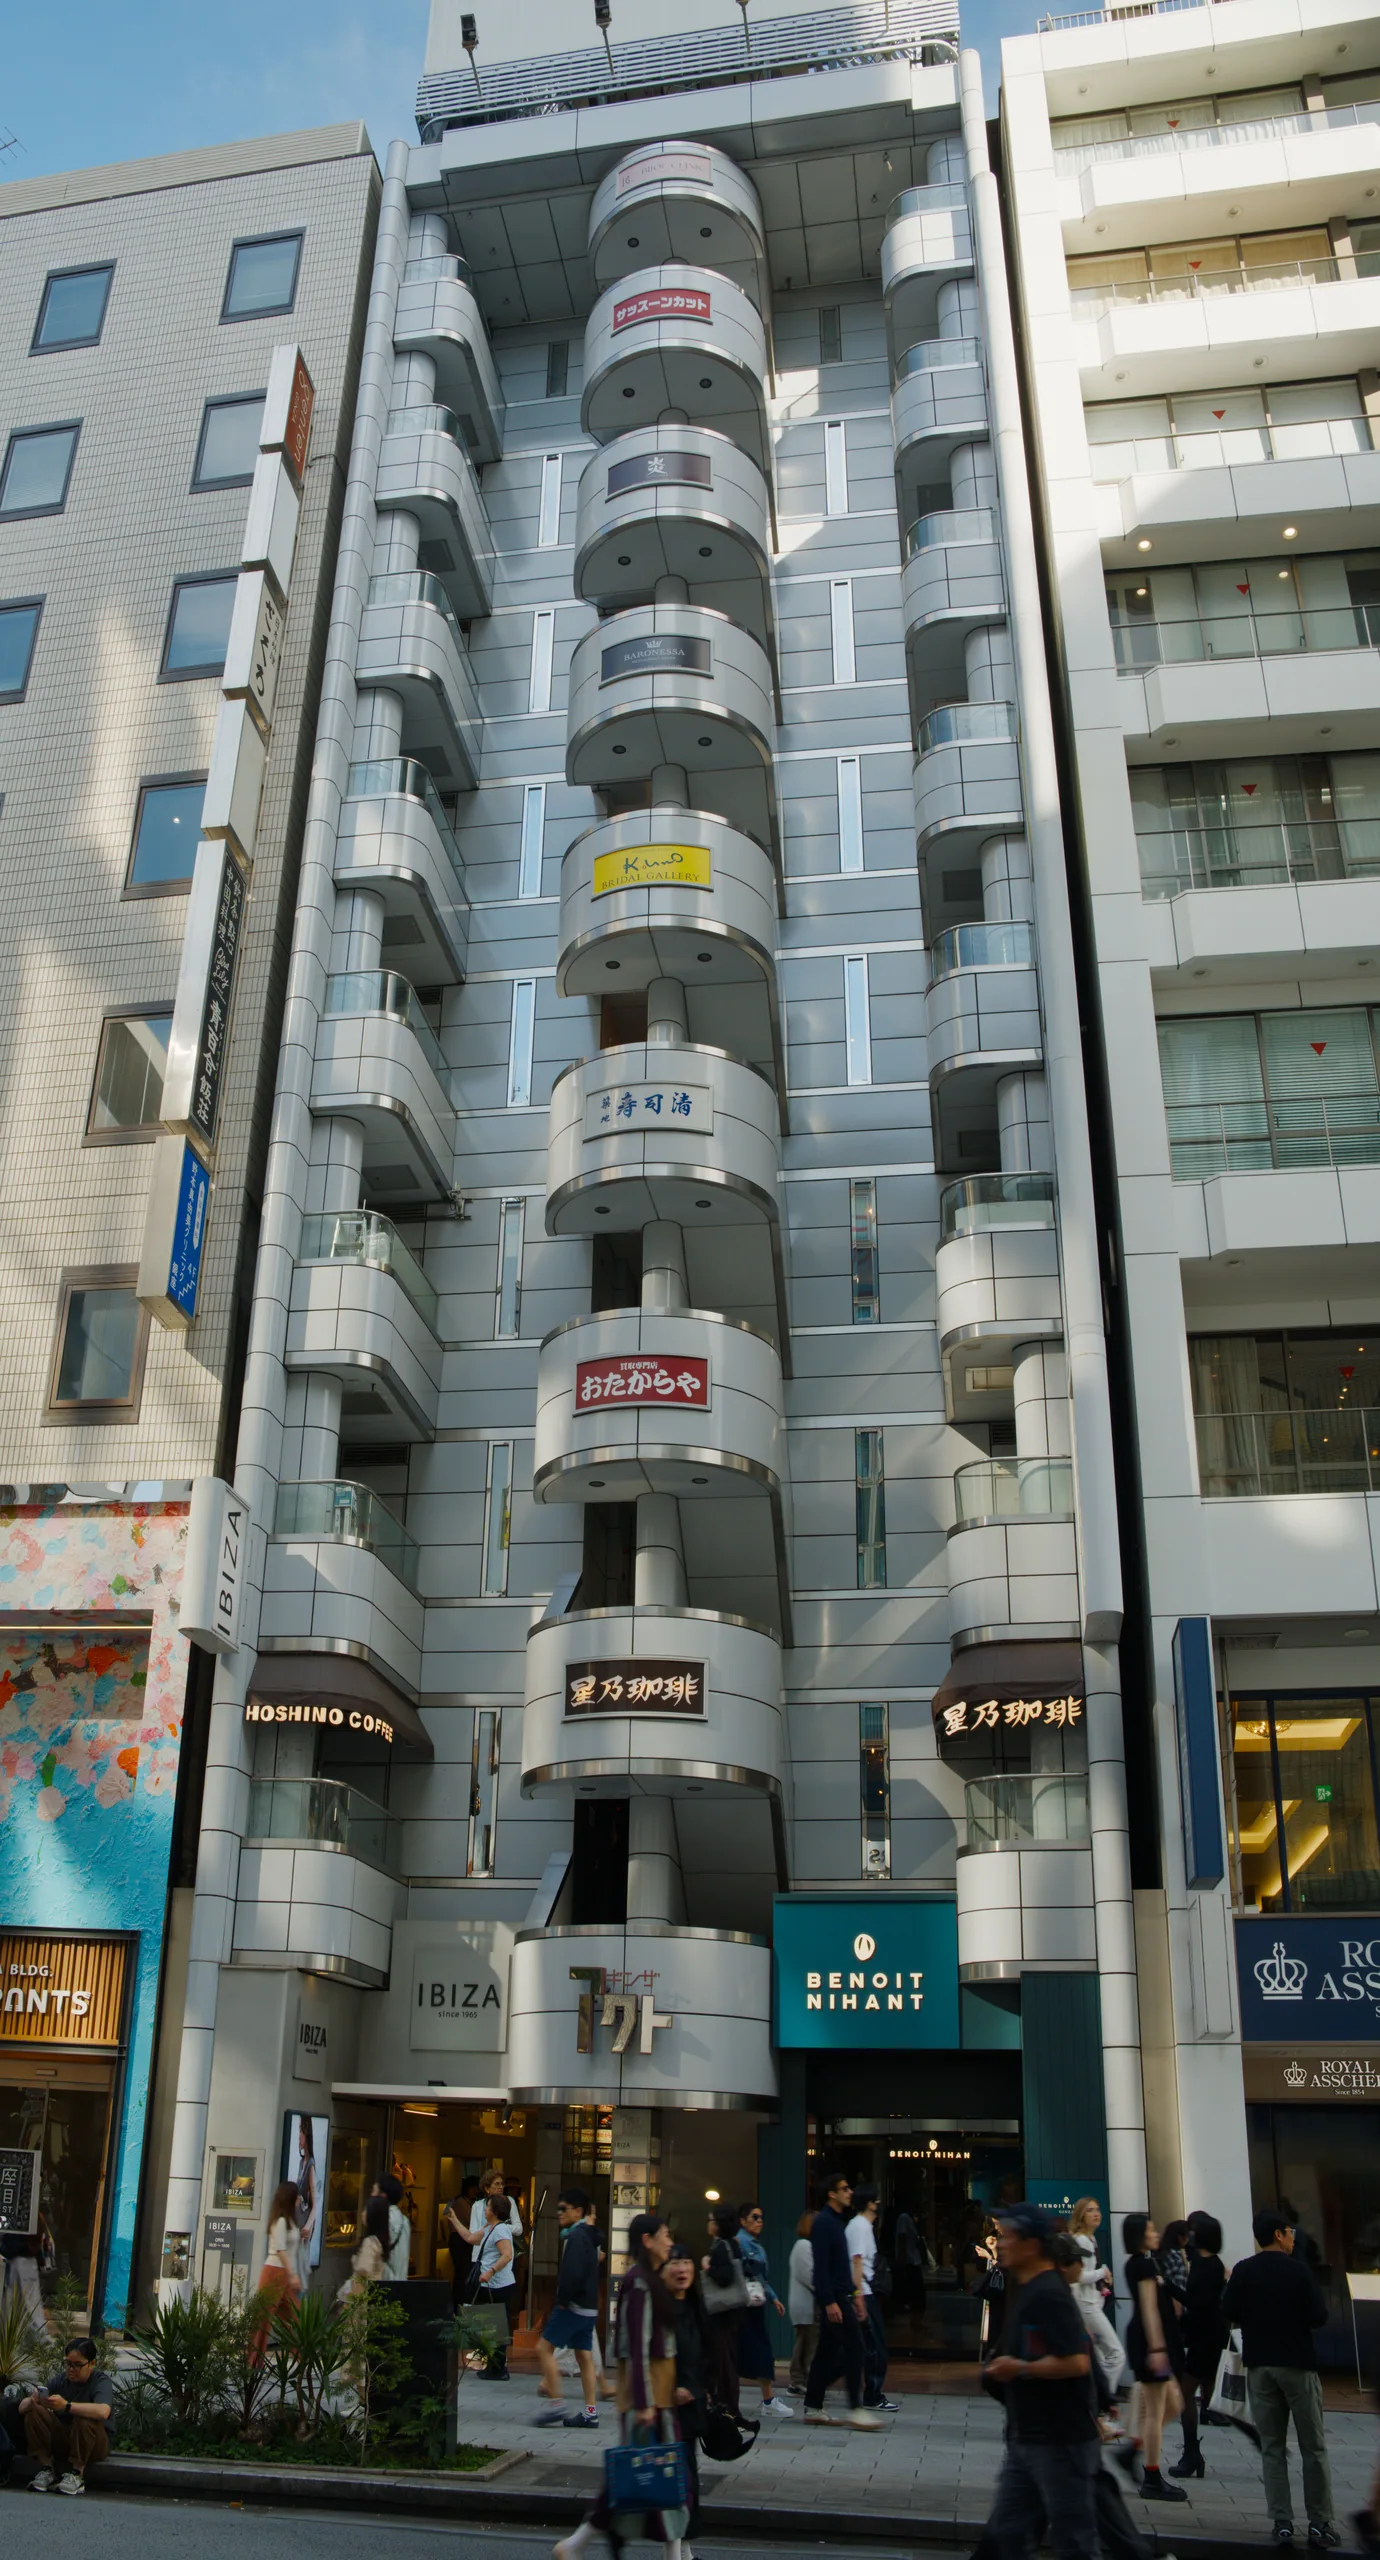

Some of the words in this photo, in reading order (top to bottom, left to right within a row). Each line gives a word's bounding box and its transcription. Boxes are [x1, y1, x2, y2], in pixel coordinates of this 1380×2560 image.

[616, 296, 707, 322] サッスーンカット
[647, 456, 667, 476] 炎
[255, 600, 275, 697] ざくろ
[624, 648, 686, 662] BARONESSA
[601, 873, 641, 890] BRIDAL
[646, 872, 700, 882] GALLERY
[581, 1369, 701, 1402] おたからや
[217, 1511, 242, 1637] IBIZA
[569, 1672, 700, 1708] 星乃珈琲
[245, 1705, 344, 1726] HOSHINO
[348, 1711, 394, 1744] COFFEE
[942, 1695, 1083, 1737] 星乃珈琲
[9, 1963, 53, 1977] BLDG.
[606, 1968, 661, 1990] ギンザ
[807, 1972, 923, 1989] BENOIT
[0, 1987, 92, 2016] ANTS
[418, 1983, 501, 2008] IBIZA
[807, 1994, 923, 2010] NIHANT
[438, 2010, 460, 2018] since
[299, 2023, 327, 2047] IBIZA
[1320, 2060, 1375, 2074] ROYAL
[889, 2150, 932, 2158] BENOIT
[225, 2188, 243, 2196] IBIZA
[2, 2205, 15, 2214] ST.
[208, 2222, 232, 2231] IBIZA
